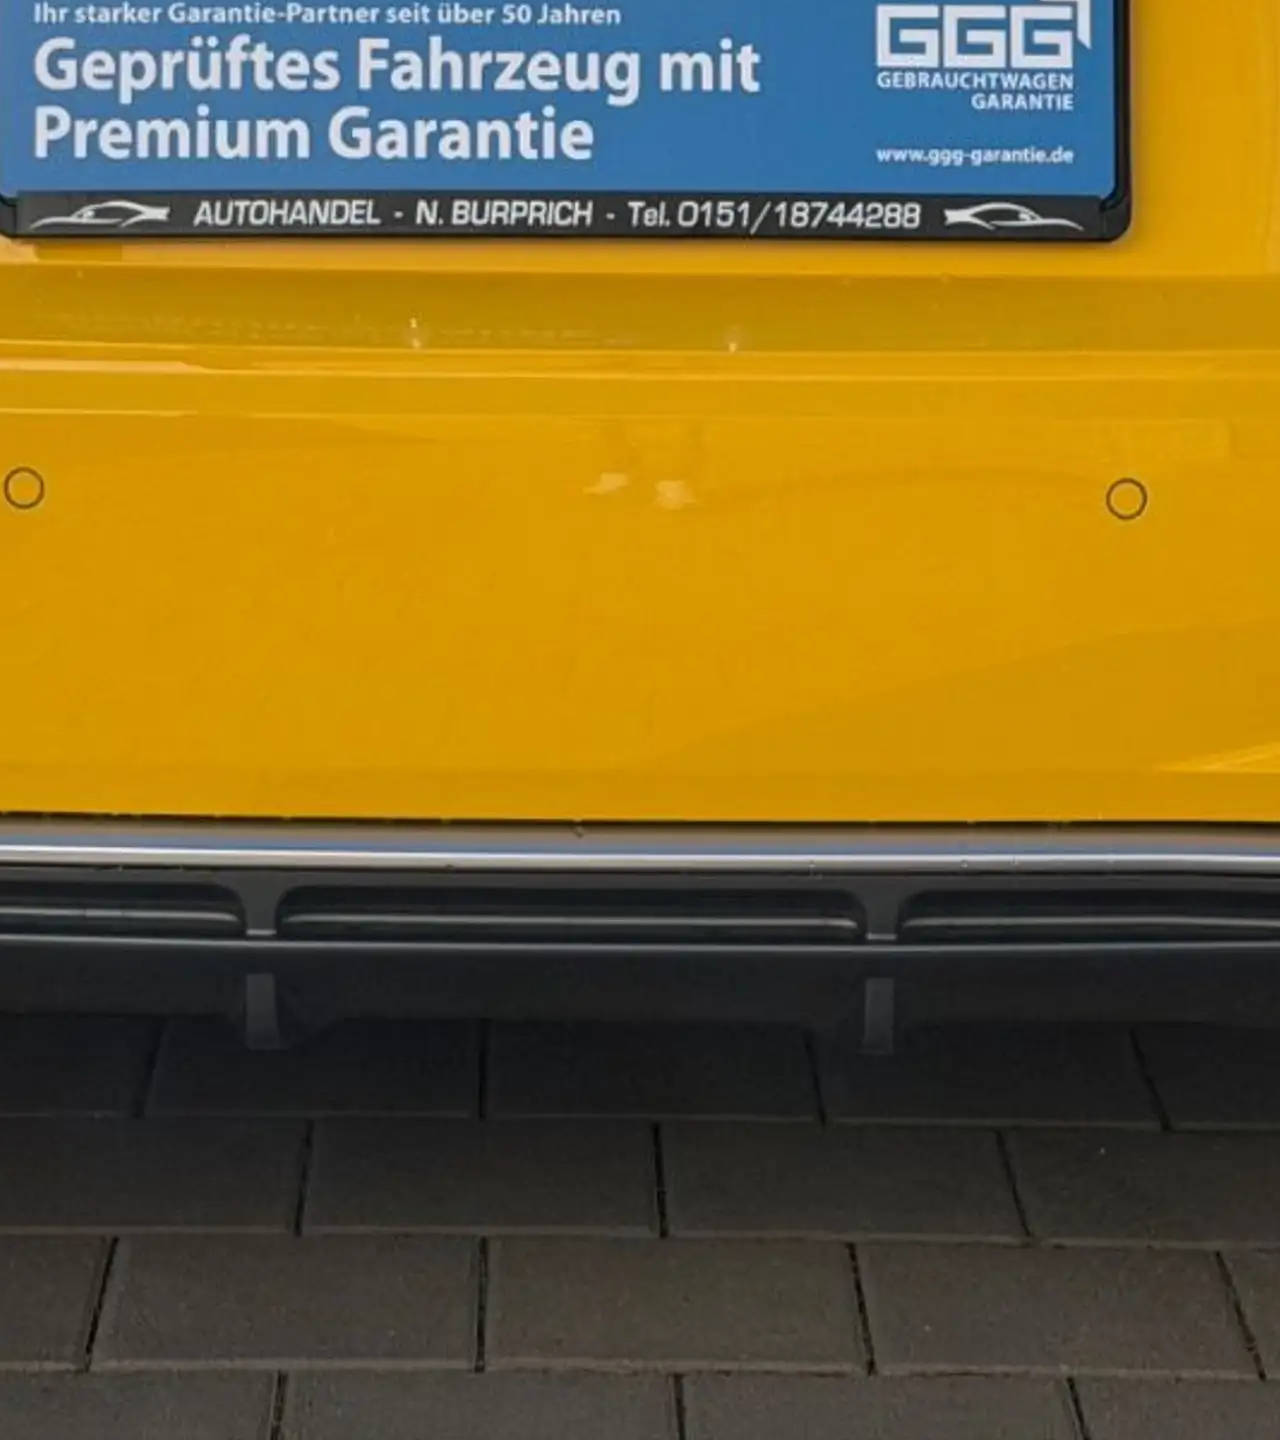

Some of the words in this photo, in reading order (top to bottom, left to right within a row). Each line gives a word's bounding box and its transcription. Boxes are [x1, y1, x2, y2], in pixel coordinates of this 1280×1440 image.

[33, 2, 70, 24] Ihr
[74, 2, 163, 24] starker
[168, 2, 381, 24] Garantie-Partner
[385, 2, 430, 24] seit
[438, 3, 494, 25] über
[501, 4, 532, 25] 50
[536, 3, 621, 25] Jahren
[876, 4, 1073, 69] GGG
[33, 34, 341, 104] Geprüftes
[357, 35, 641, 107] Fahrzeug
[659, 37, 761, 92] mit
[876, 71, 1074, 90] GEBRAUCHTWAGEN
[971, 93, 1074, 111] GARANTIE
[33, 103, 310, 159] Premium
[328, 104, 594, 160] Garantie
[876, 146, 1074, 166] www.ggg-garantie.de
[194, 200, 381, 227] AUTOHANDEL
[415, 201, 444, 226] N.
[451, 201, 594, 227] BURPRICH
[627, 201, 670, 227] Tel.
[677, 201, 922, 235] 0151/18744288
